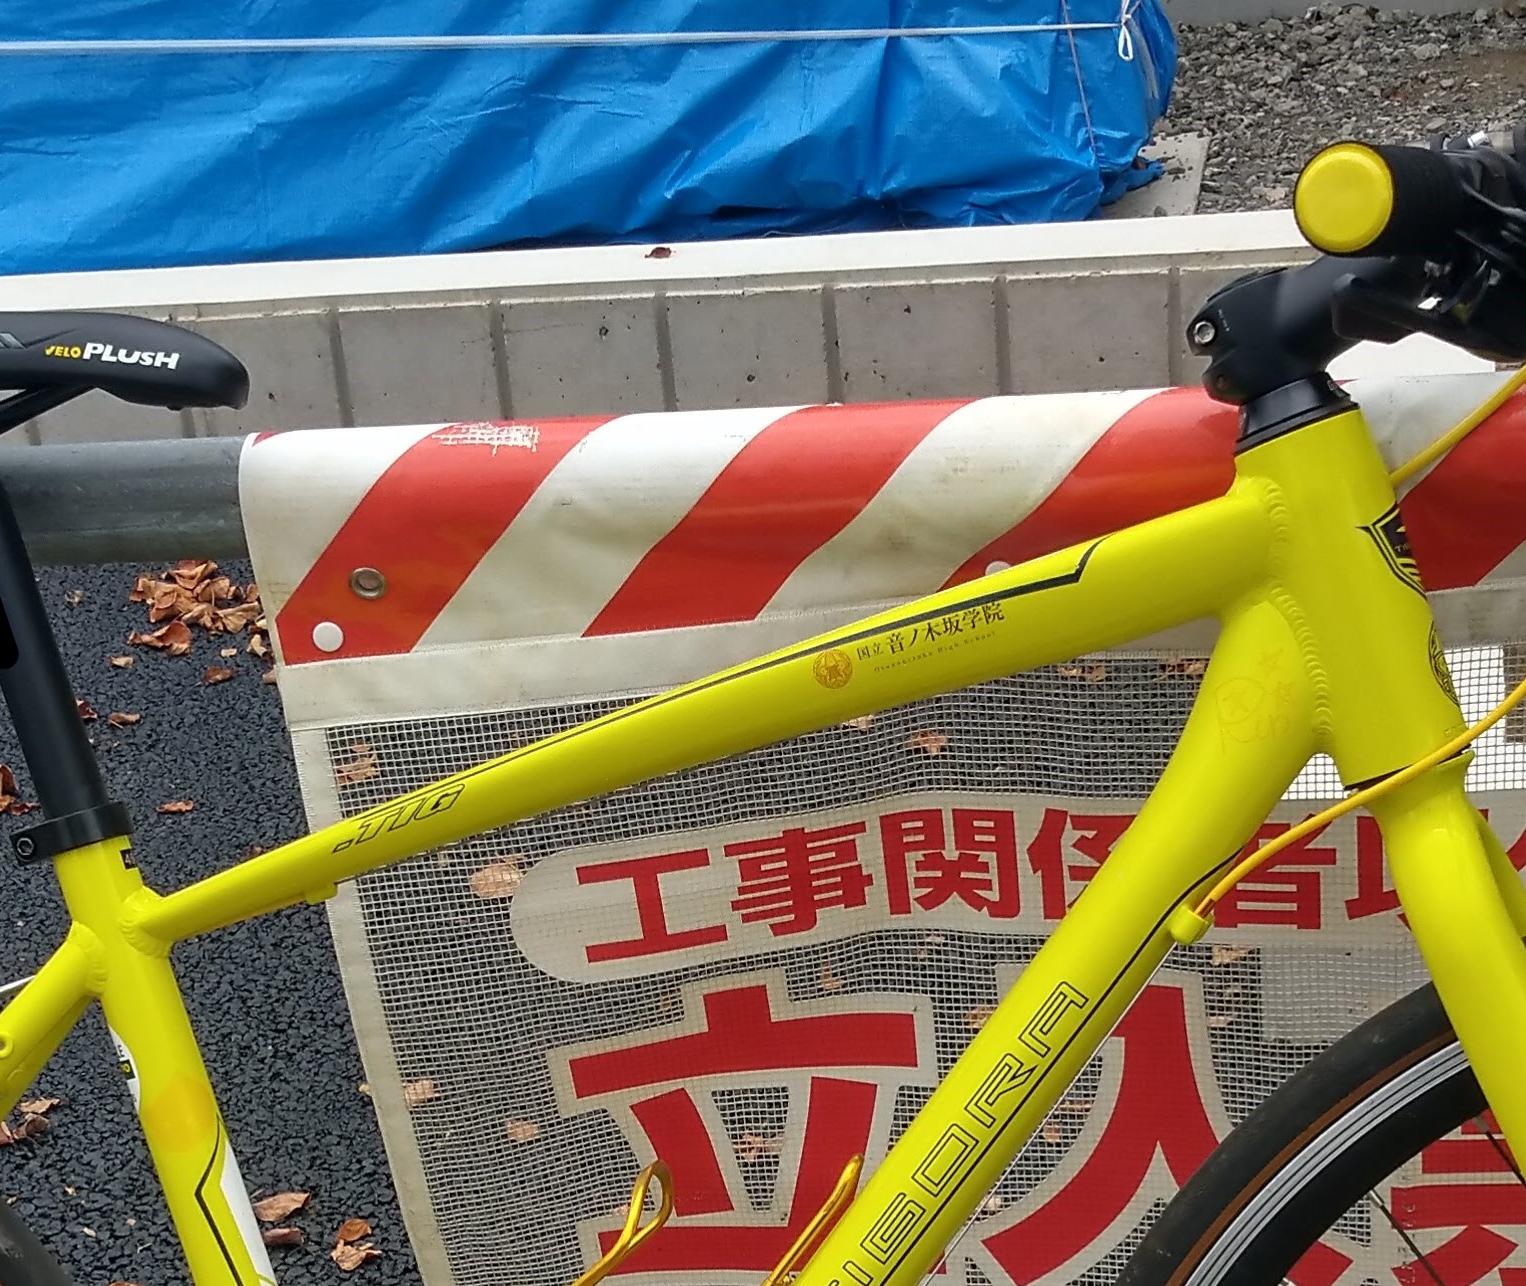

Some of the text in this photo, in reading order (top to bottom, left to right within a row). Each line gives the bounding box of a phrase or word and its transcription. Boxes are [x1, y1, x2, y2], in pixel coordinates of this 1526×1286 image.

[83, 342, 180, 370] PLUSH
[856, 601, 1005, 661] 国立 音ノ木坂学院
